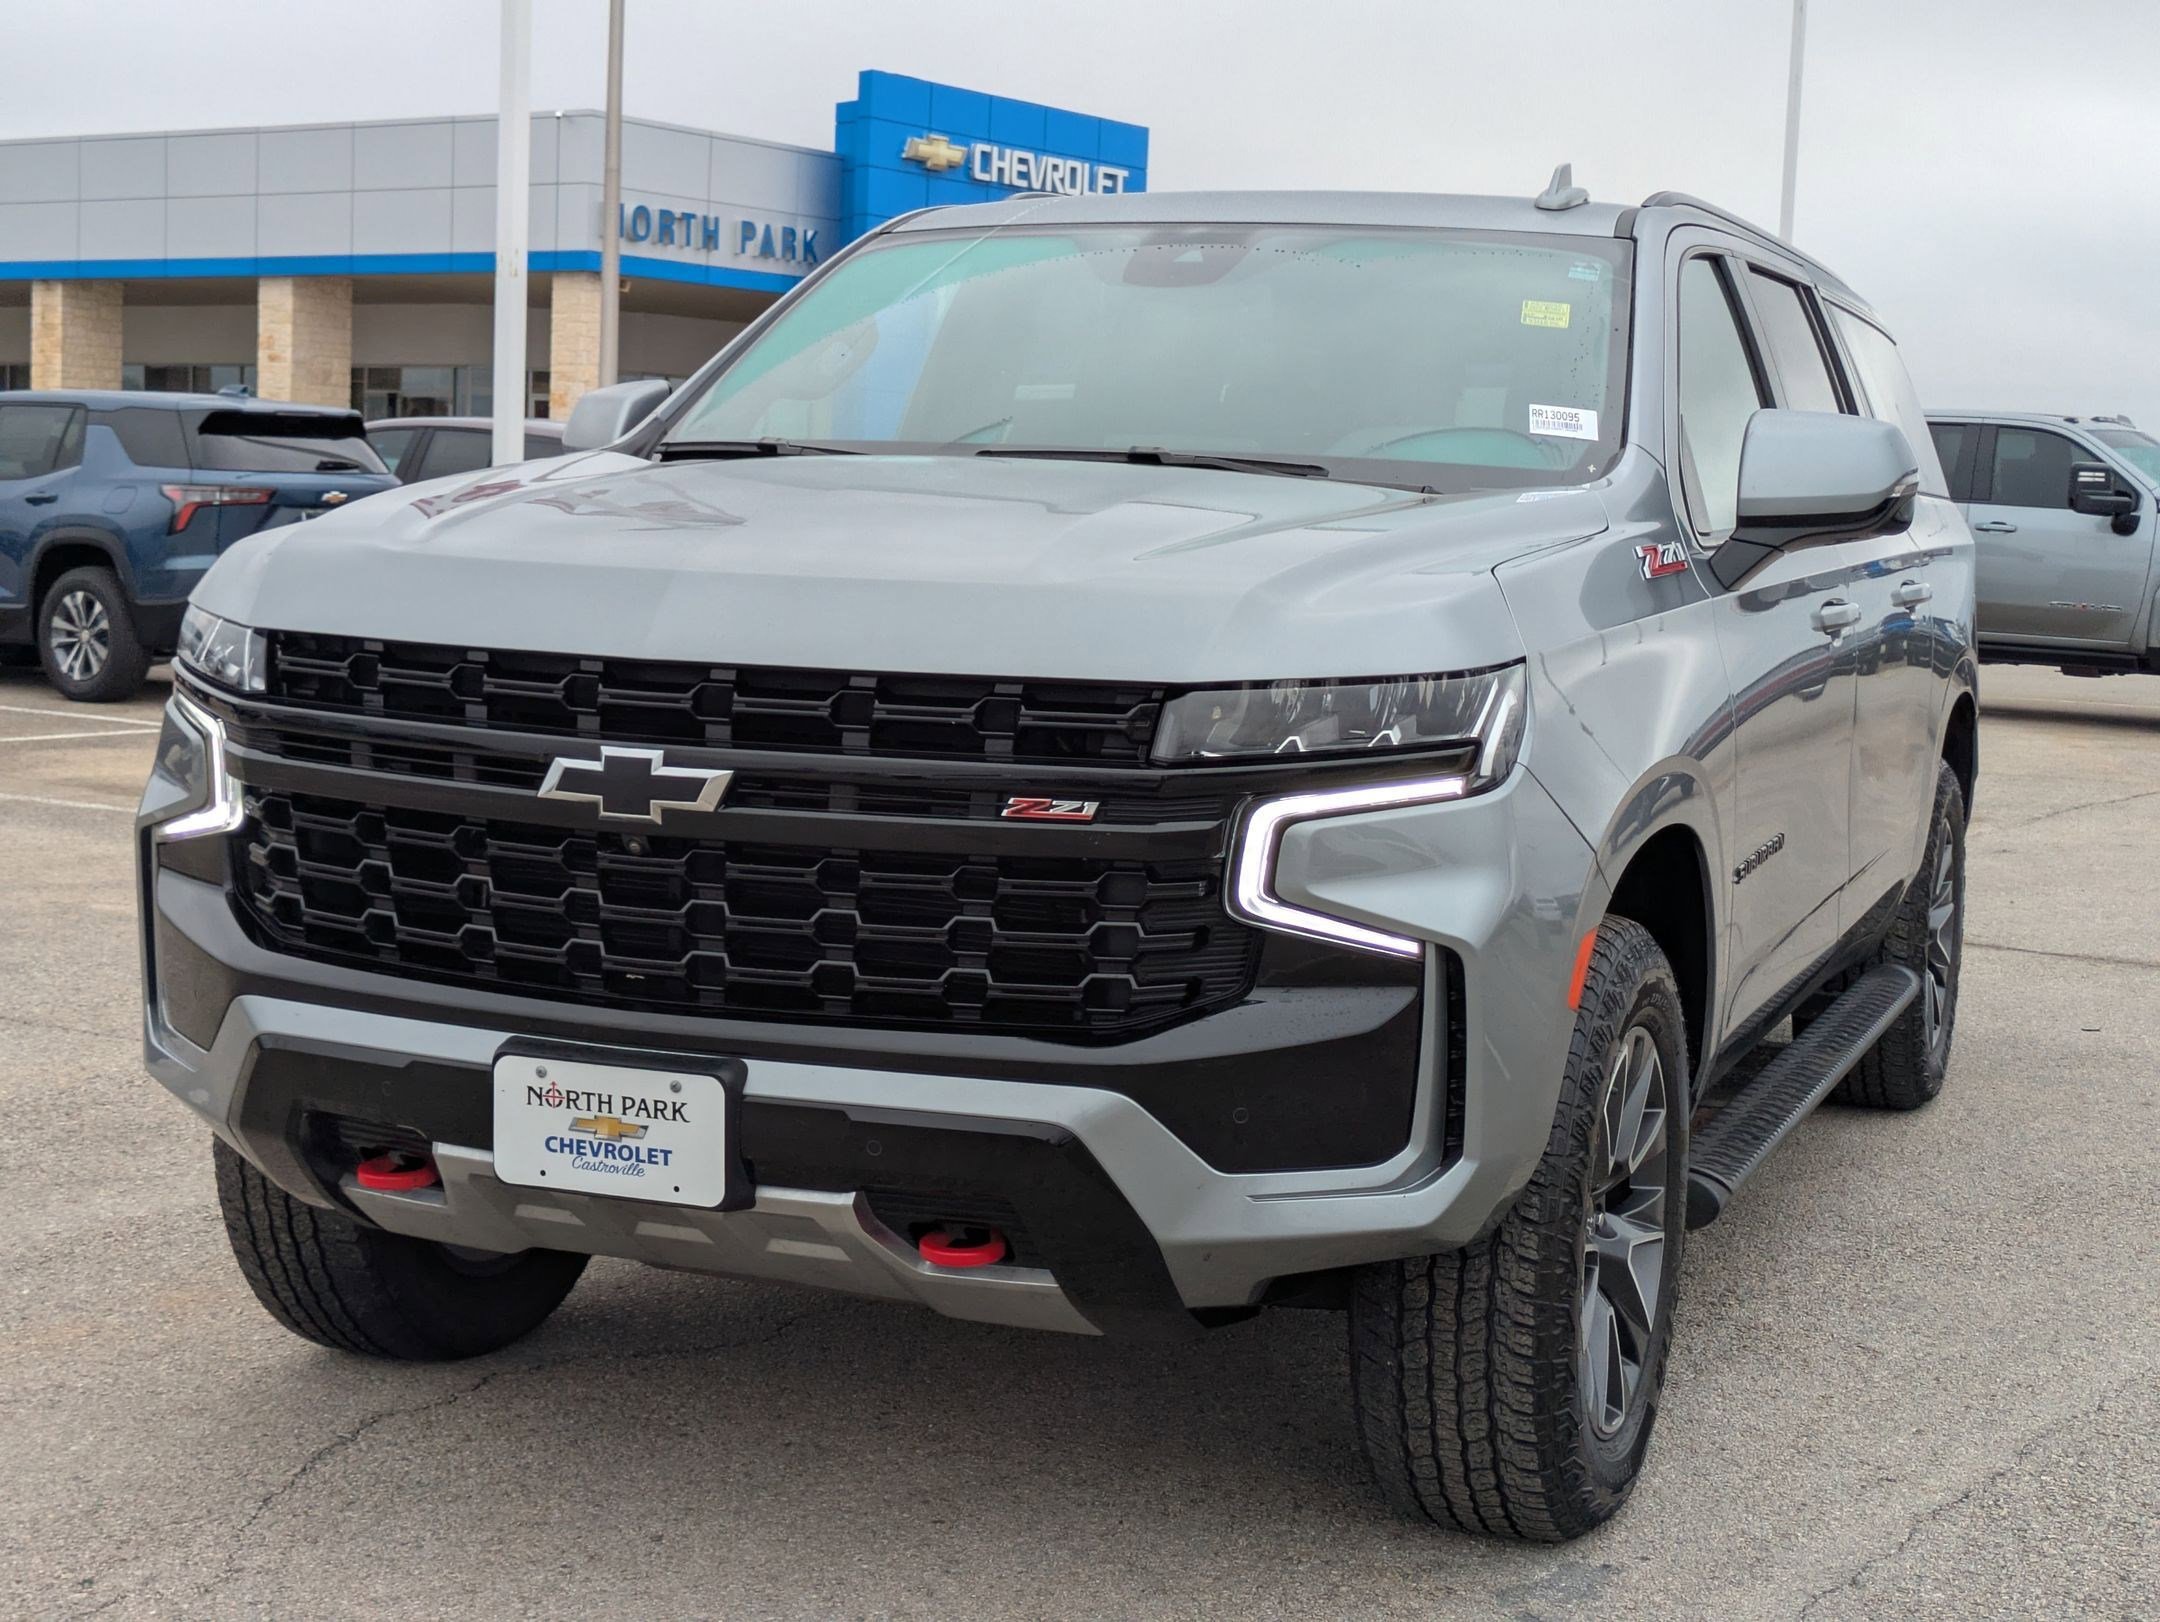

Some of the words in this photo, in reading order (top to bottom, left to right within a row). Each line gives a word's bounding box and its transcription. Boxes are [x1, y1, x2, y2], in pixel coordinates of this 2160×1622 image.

[972, 143, 1129, 195] CHEVROLET
[740, 220, 819, 263] PARK
[1532, 409, 1580, 422] RR130095
[1632, 541, 1688, 580] Z71
[1001, 797, 1099, 820] Z71
[527, 1081, 613, 1115] NORTH
[621, 1096, 691, 1123] PARK
[545, 1136, 672, 1166] CHEVROLET
[571, 1155, 645, 1177] Castroville
